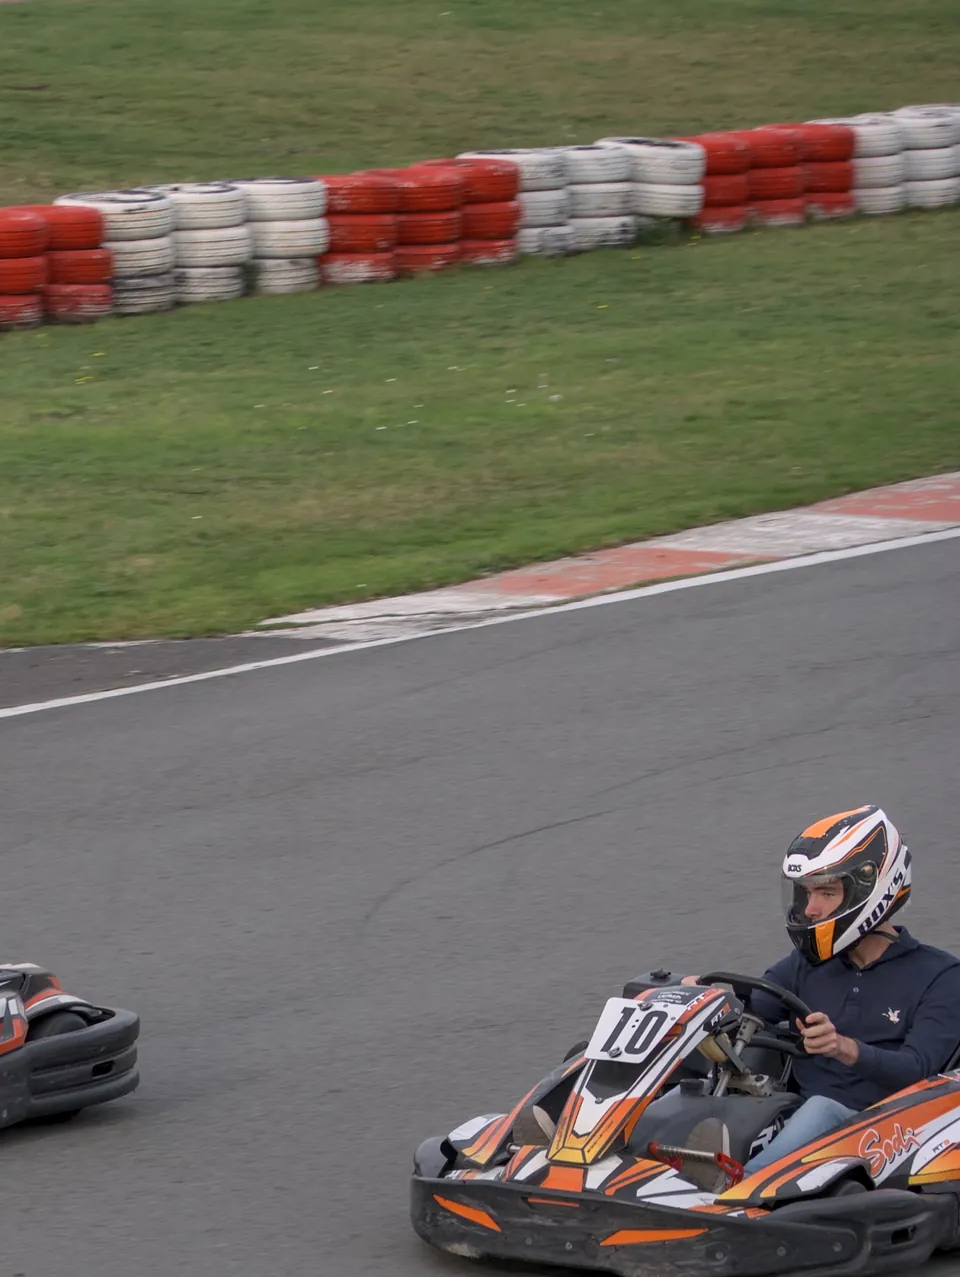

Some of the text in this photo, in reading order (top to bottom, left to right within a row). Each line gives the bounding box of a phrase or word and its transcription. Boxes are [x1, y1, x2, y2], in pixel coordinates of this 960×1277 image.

[857, 871, 904, 936] BOX'S
[599, 1006, 669, 1056] 10
[858, 1123, 922, 1179] Sodi
